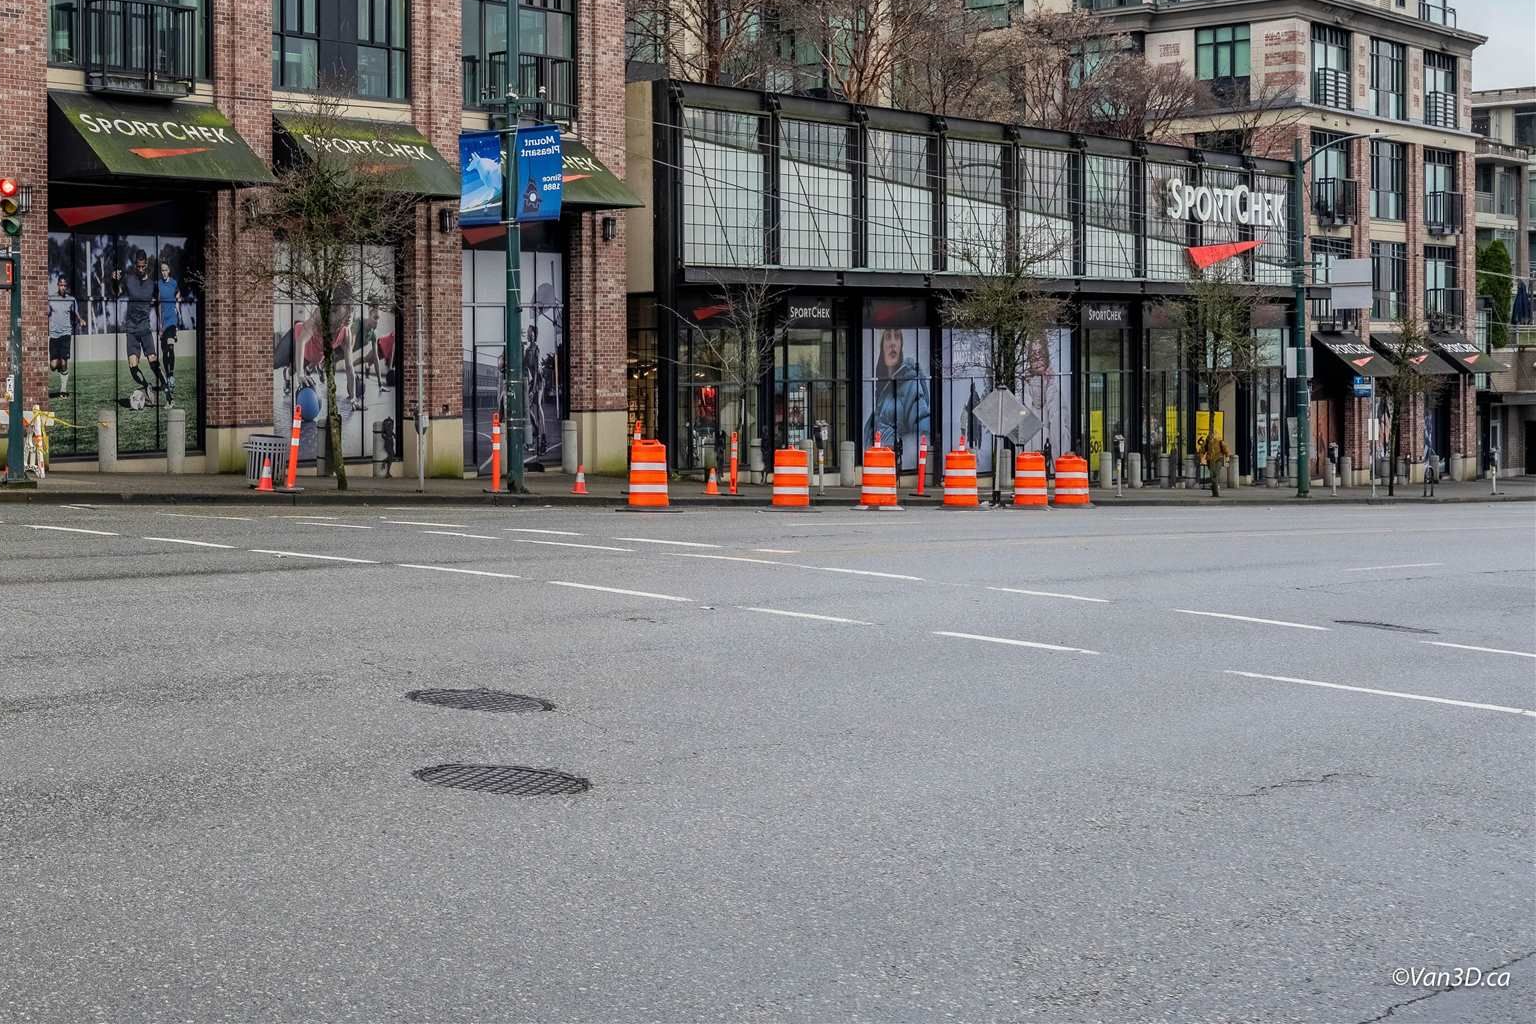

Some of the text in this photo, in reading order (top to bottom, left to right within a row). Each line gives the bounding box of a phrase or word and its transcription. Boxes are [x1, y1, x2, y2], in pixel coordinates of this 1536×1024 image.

[79, 114, 234, 145] SPORTCHEK
[1166, 178, 1285, 227] SPORTCHEK
[790, 306, 830, 318] SPORTCHEK
[1088, 309, 1122, 321] SPORTCHEK
